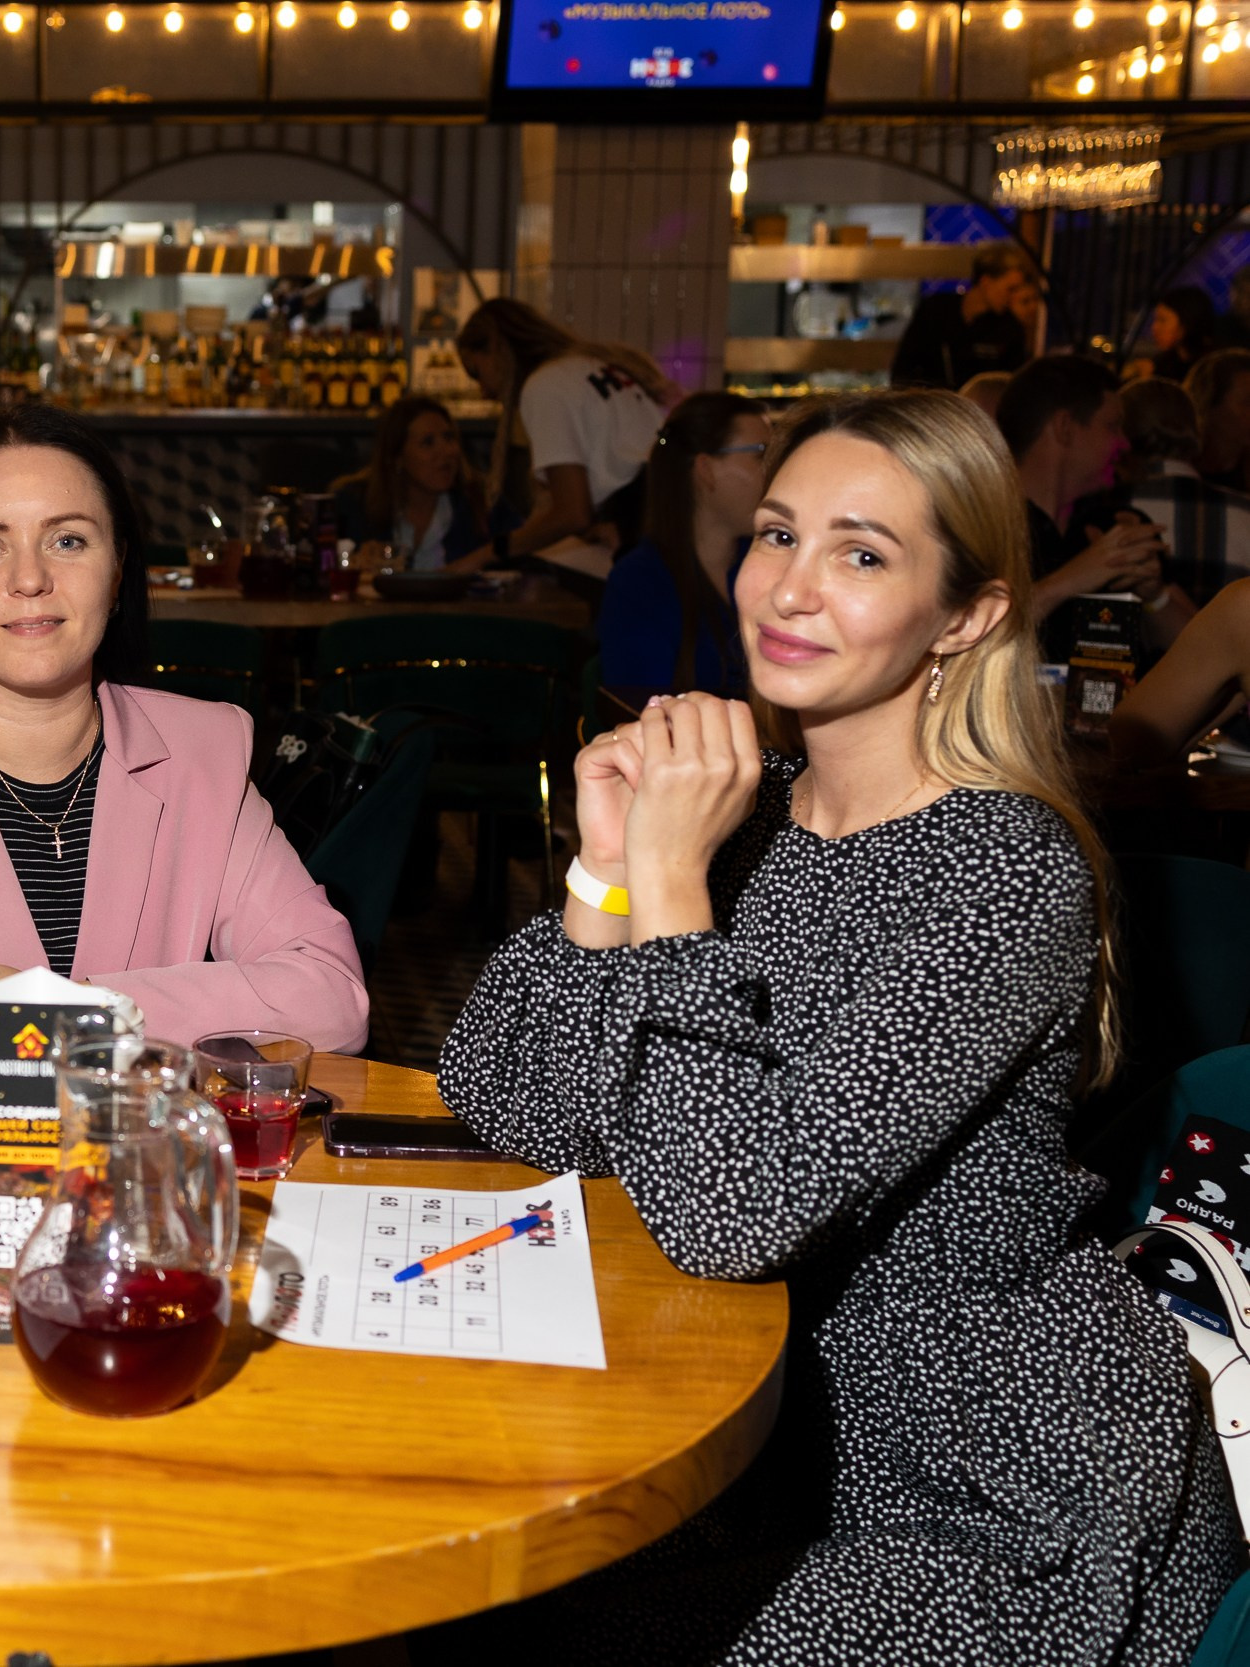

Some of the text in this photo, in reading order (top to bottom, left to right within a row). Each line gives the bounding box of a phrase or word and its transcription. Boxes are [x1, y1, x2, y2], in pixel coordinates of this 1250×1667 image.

[380, 1196, 399, 1207] 89
[422, 1199, 441, 1209] 86
[422, 1214, 441, 1224] 70
[465, 1217, 484, 1227] 77
[378, 1226, 396, 1236] 63
[375, 1257, 394, 1268] 47
[465, 1263, 485, 1274] 45
[419, 1278, 439, 1288] 34
[465, 1281, 486, 1291] 32
[371, 1291, 392, 1303] 28
[418, 1295, 438, 1306] 20
[465, 1316, 487, 1326] 11
